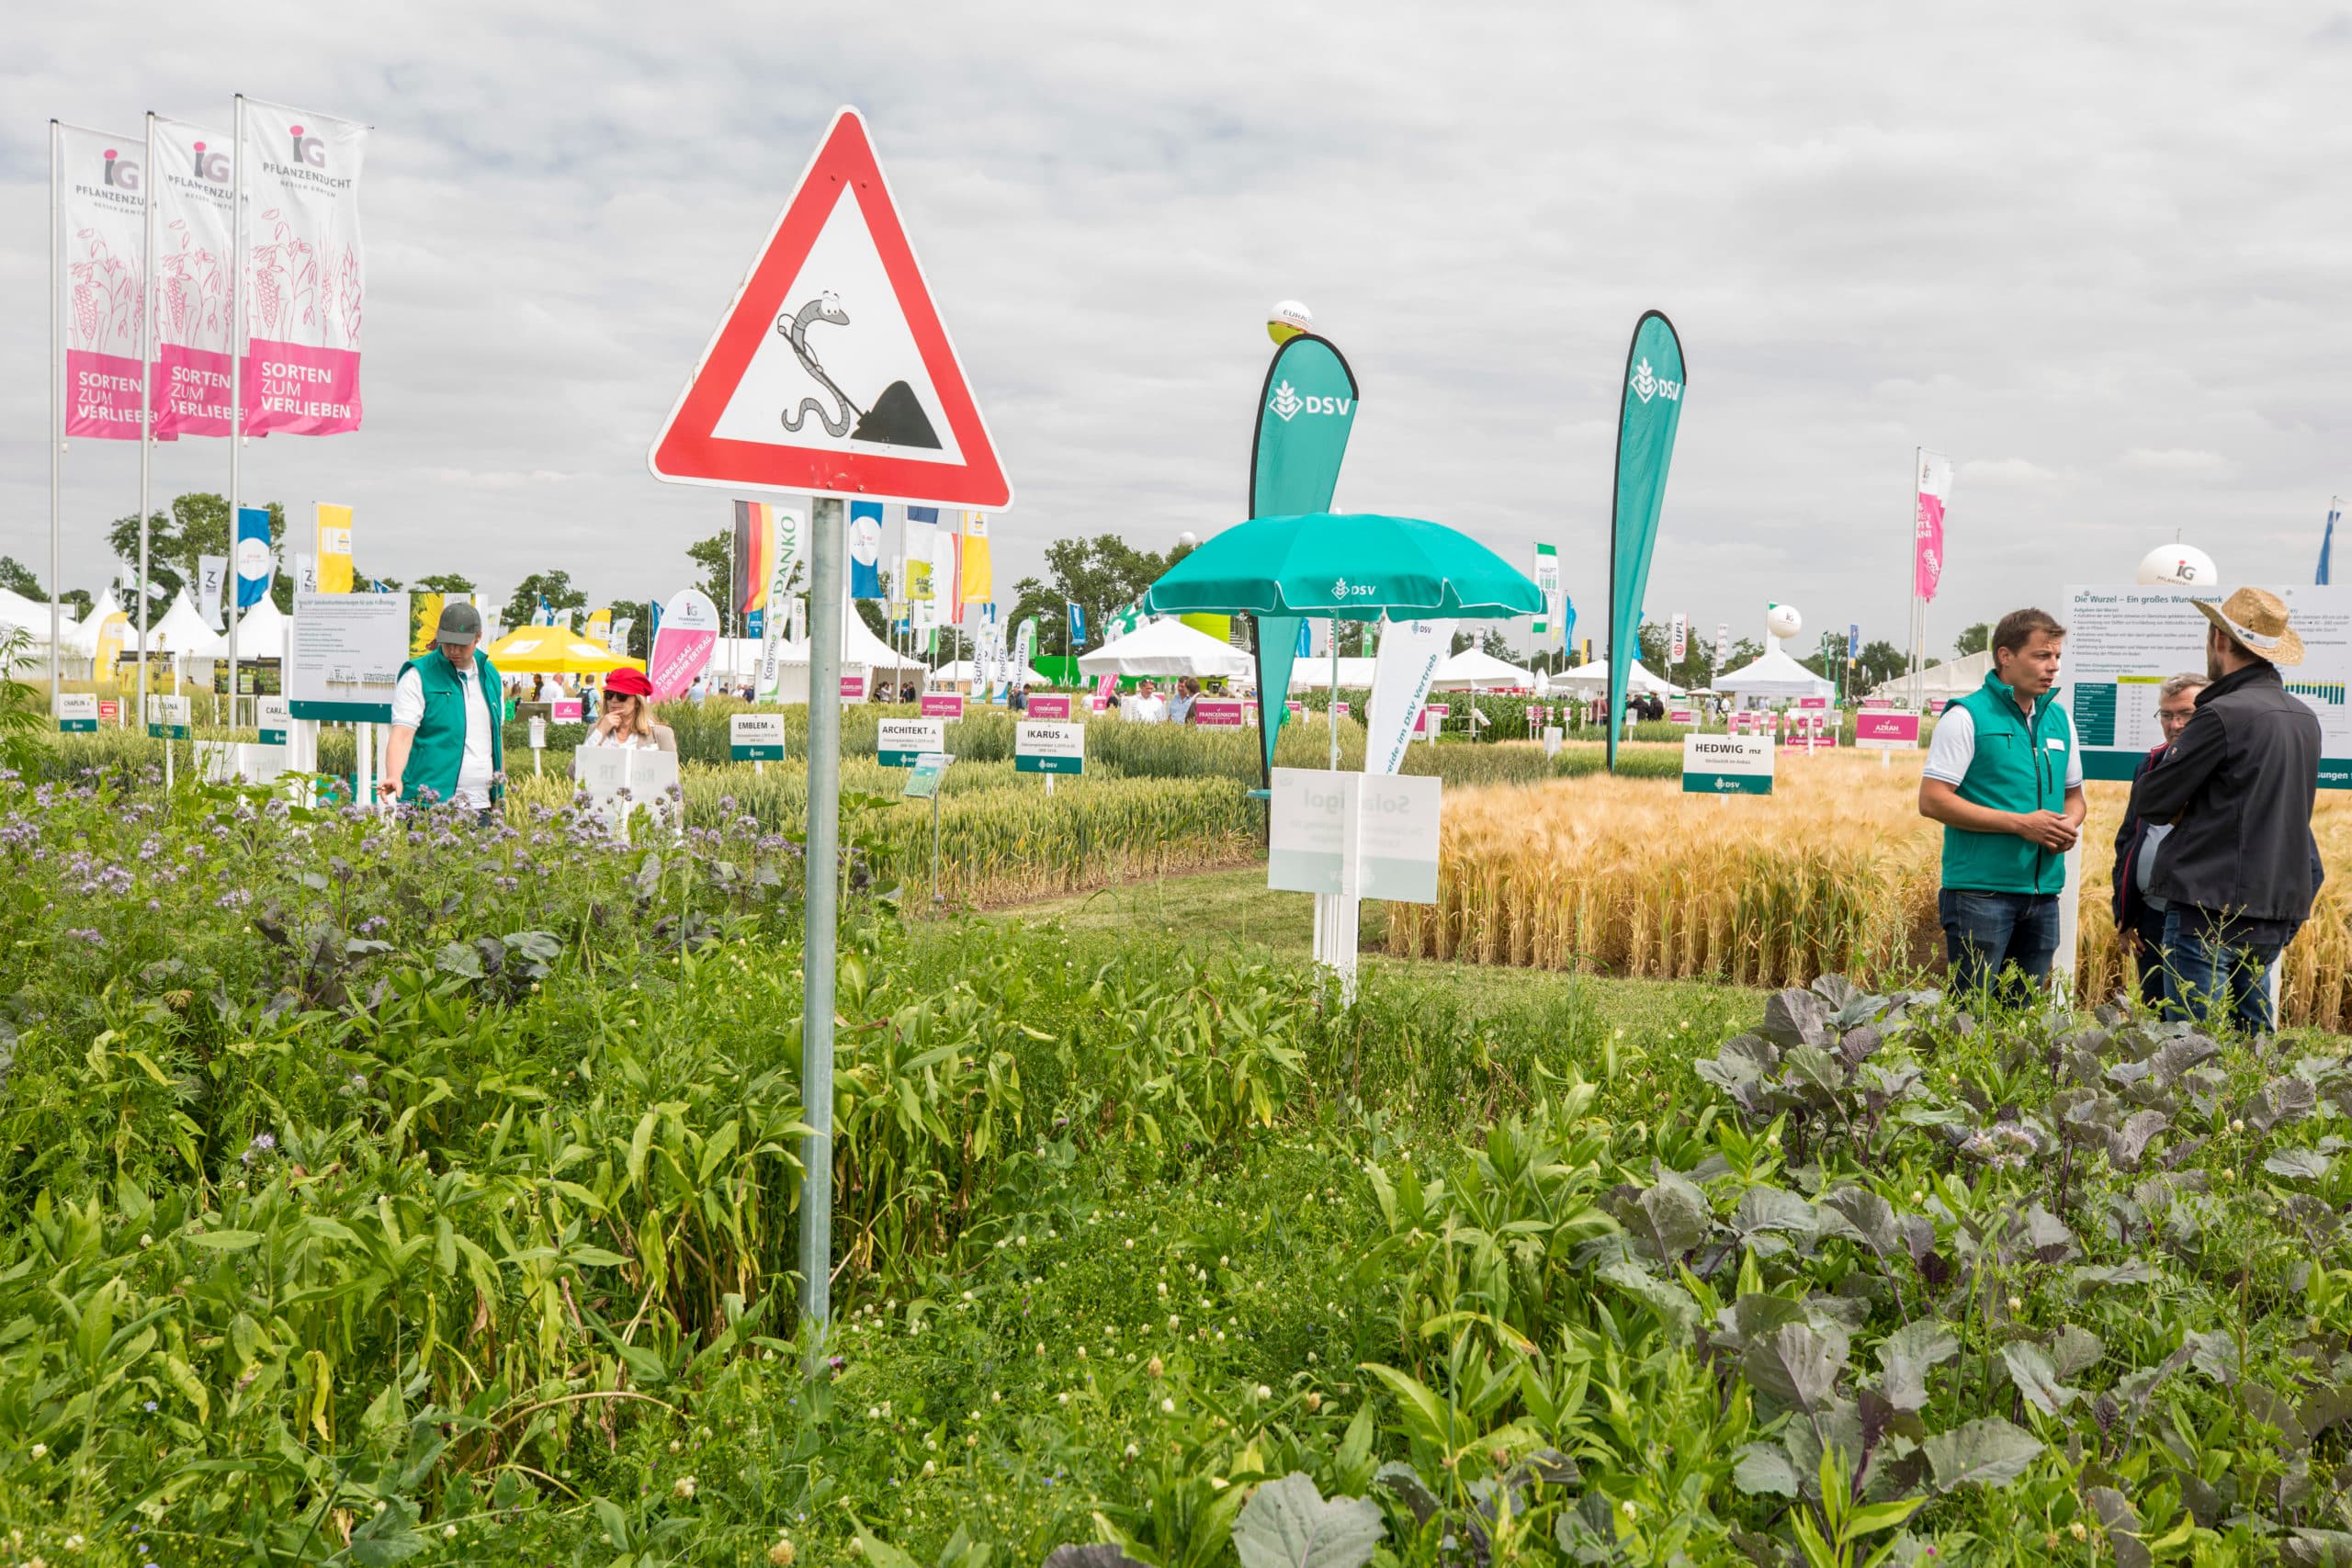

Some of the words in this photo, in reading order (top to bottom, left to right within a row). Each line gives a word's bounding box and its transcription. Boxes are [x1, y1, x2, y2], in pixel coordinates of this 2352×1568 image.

[263, 163, 352, 189] PFLANZENZUCHT
[76, 185, 157, 209] PFLANZENZUH
[79, 372, 142, 392] SORTEN
[171, 366, 231, 389] SORTEN
[262, 361, 332, 384] SORTEN
[78, 388, 112, 404] ZUM
[171, 383, 204, 400] ZUM
[262, 378, 300, 397] ZUM
[1658, 378, 1681, 401] DSV
[261, 396, 352, 419] VERLIEBEN
[1306, 396, 1351, 416] DSV
[774, 515, 796, 594] DANKO
[1351, 585, 1376, 596] DSV
[2075, 595, 2087, 604] Die
[2089, 595, 2117, 604] Wurzel
[2127, 595, 2139, 604] Ein
[2141, 595, 2169, 606] großes
[1419, 626, 1432, 634] DSV
[655, 660, 678, 688] STARKE
[676, 643, 692, 662] SAAT
[673, 660, 691, 682] MEHR
[688, 634, 712, 662] ERTRAG
[997, 648, 1006, 682] Fredro
[1396, 729, 1408, 743] im
[1404, 703, 1417, 728] DSV
[1414, 653, 1438, 699] Vertrieb
[882, 726, 928, 735] ARCHITEKT
[1027, 730, 1060, 739] IKARUS
[1695, 743, 1744, 754] HEDWIG
[2317, 772, 2348, 781] sungen
